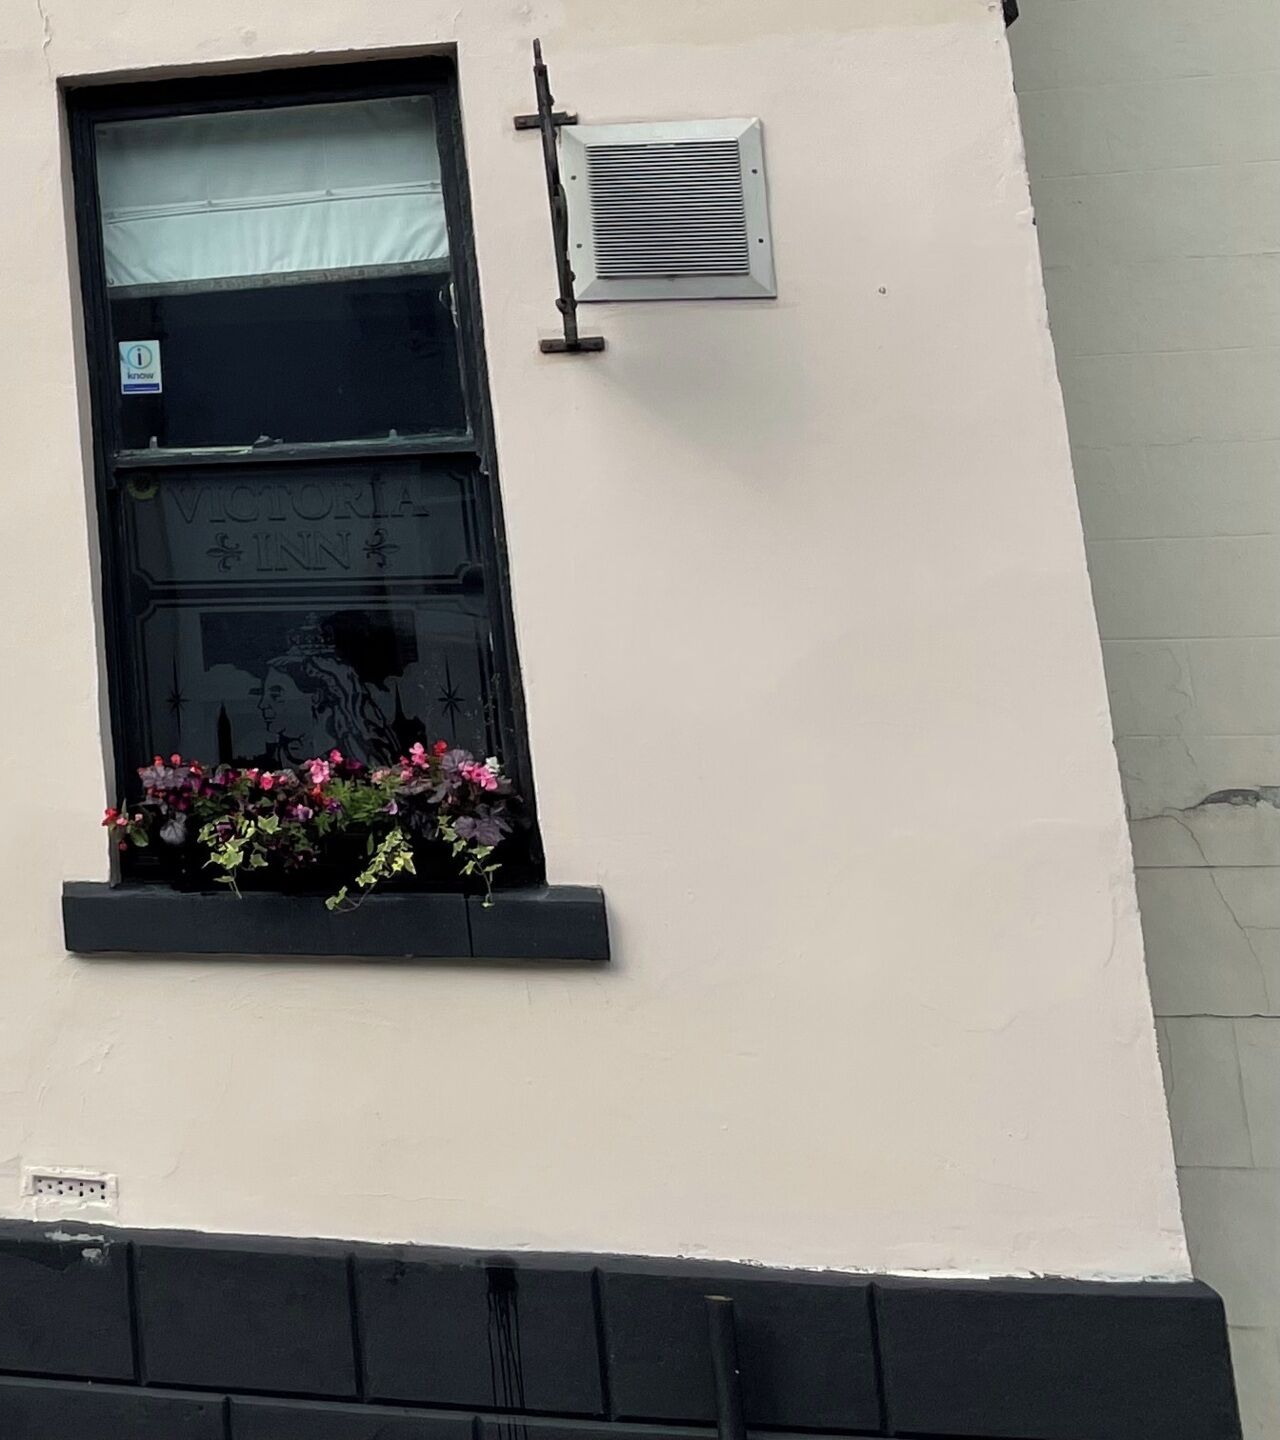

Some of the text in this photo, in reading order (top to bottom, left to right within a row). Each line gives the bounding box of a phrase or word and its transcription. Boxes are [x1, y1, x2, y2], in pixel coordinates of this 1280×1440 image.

[127, 371, 154, 380] know
[166, 474, 430, 524] VICTORIA
[252, 529, 351, 572] INN
